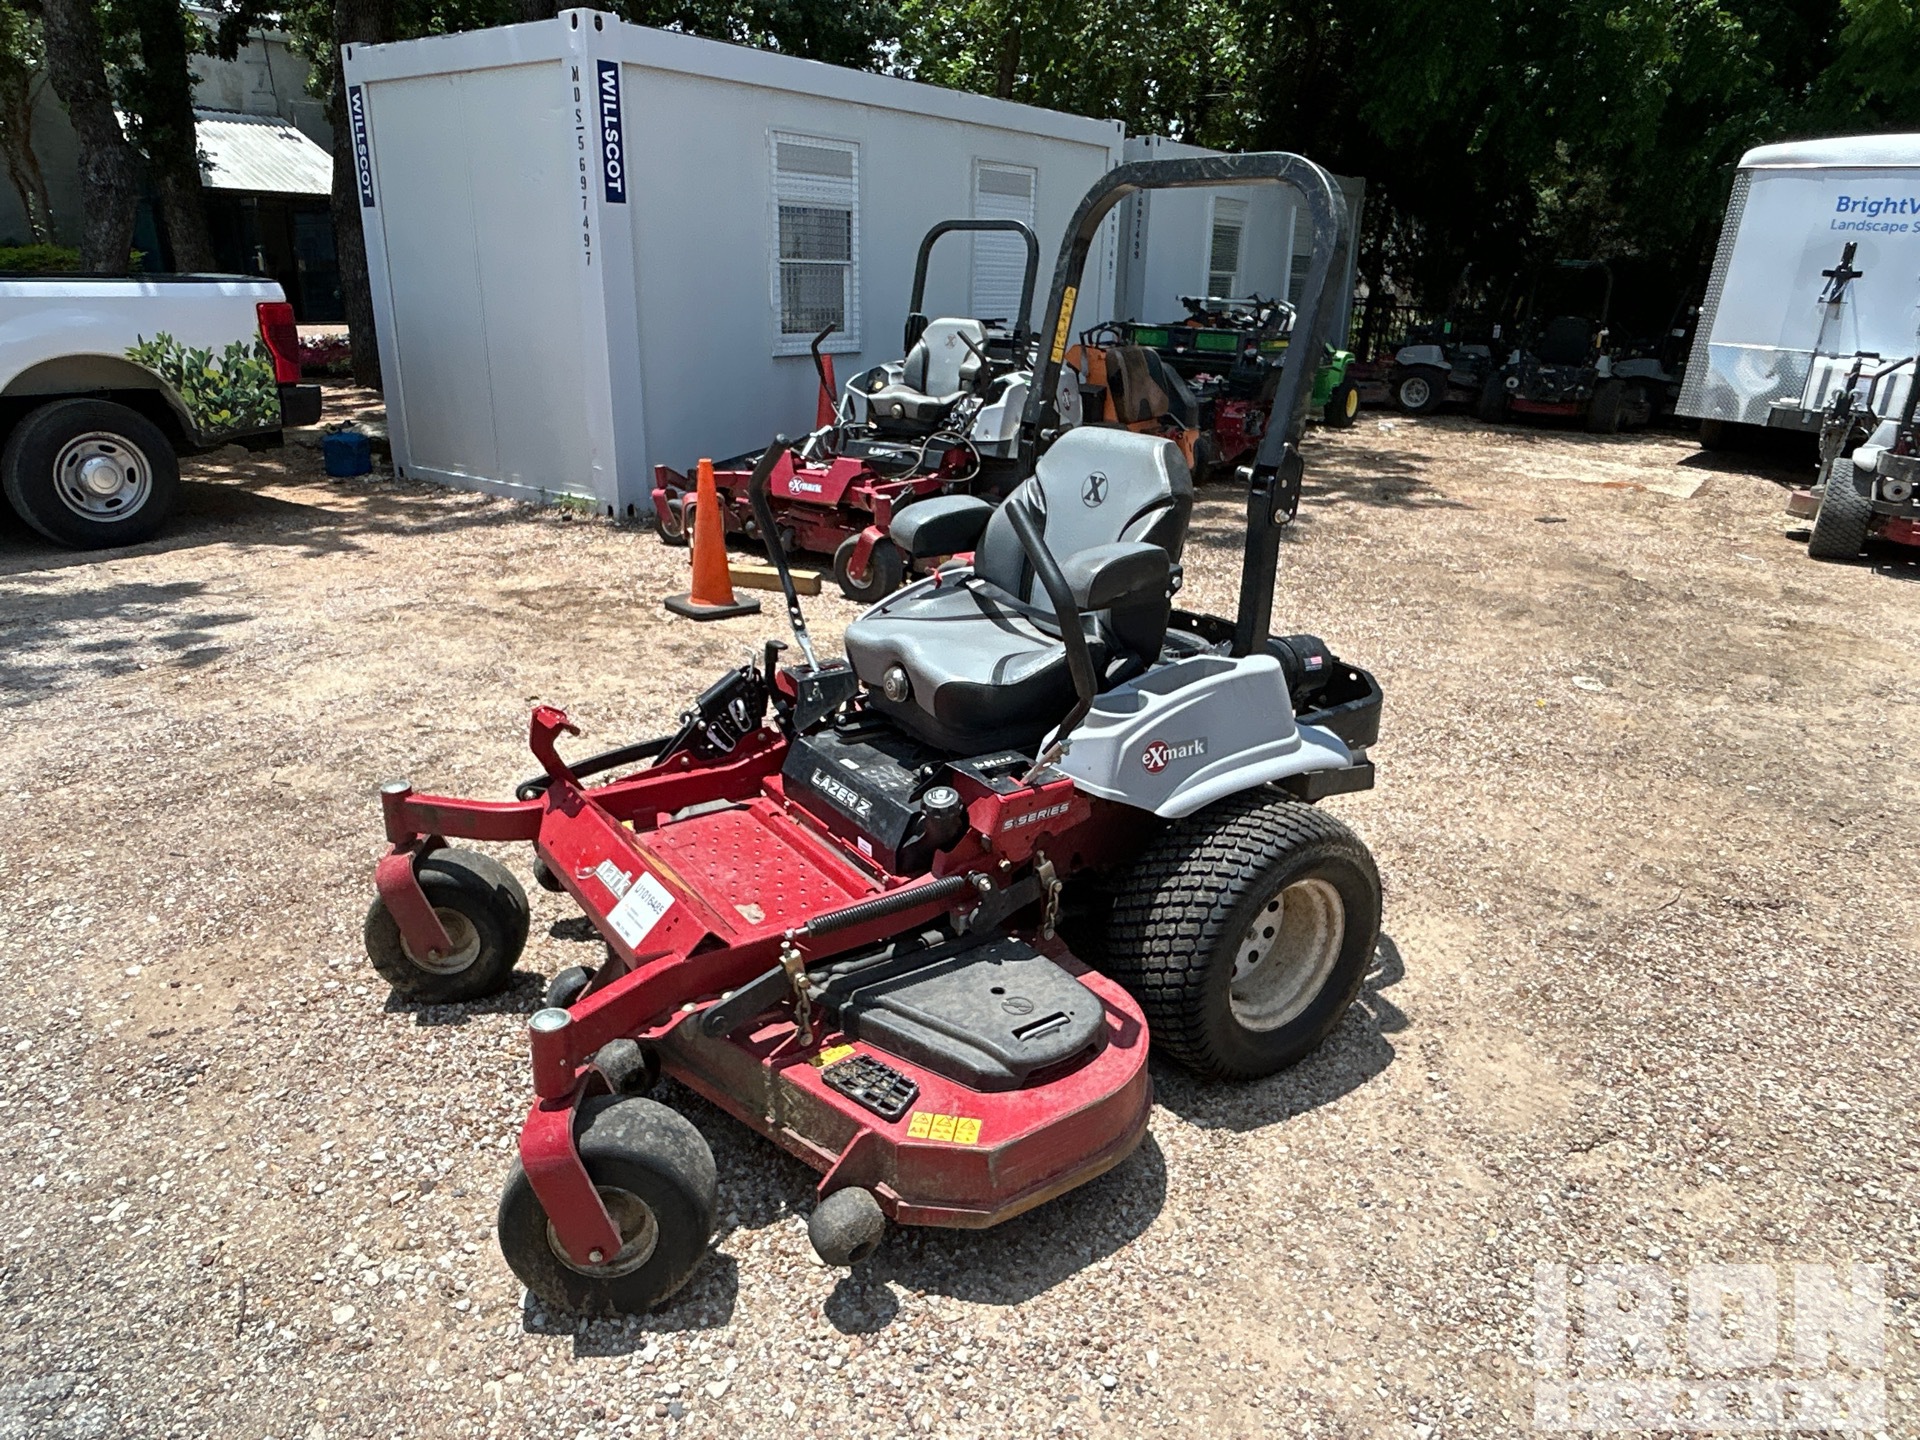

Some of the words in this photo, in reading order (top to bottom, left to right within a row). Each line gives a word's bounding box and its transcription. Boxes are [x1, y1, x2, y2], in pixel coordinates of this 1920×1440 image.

[352, 93, 372, 198] WILLSCOT
[571, 66, 591, 266] MDS-5697497
[601, 70, 622, 192] WILLSCOT
[1830, 219, 1908, 234] Landscape
[811, 768, 857, 809] LAZER
[853, 798, 872, 818] Z
